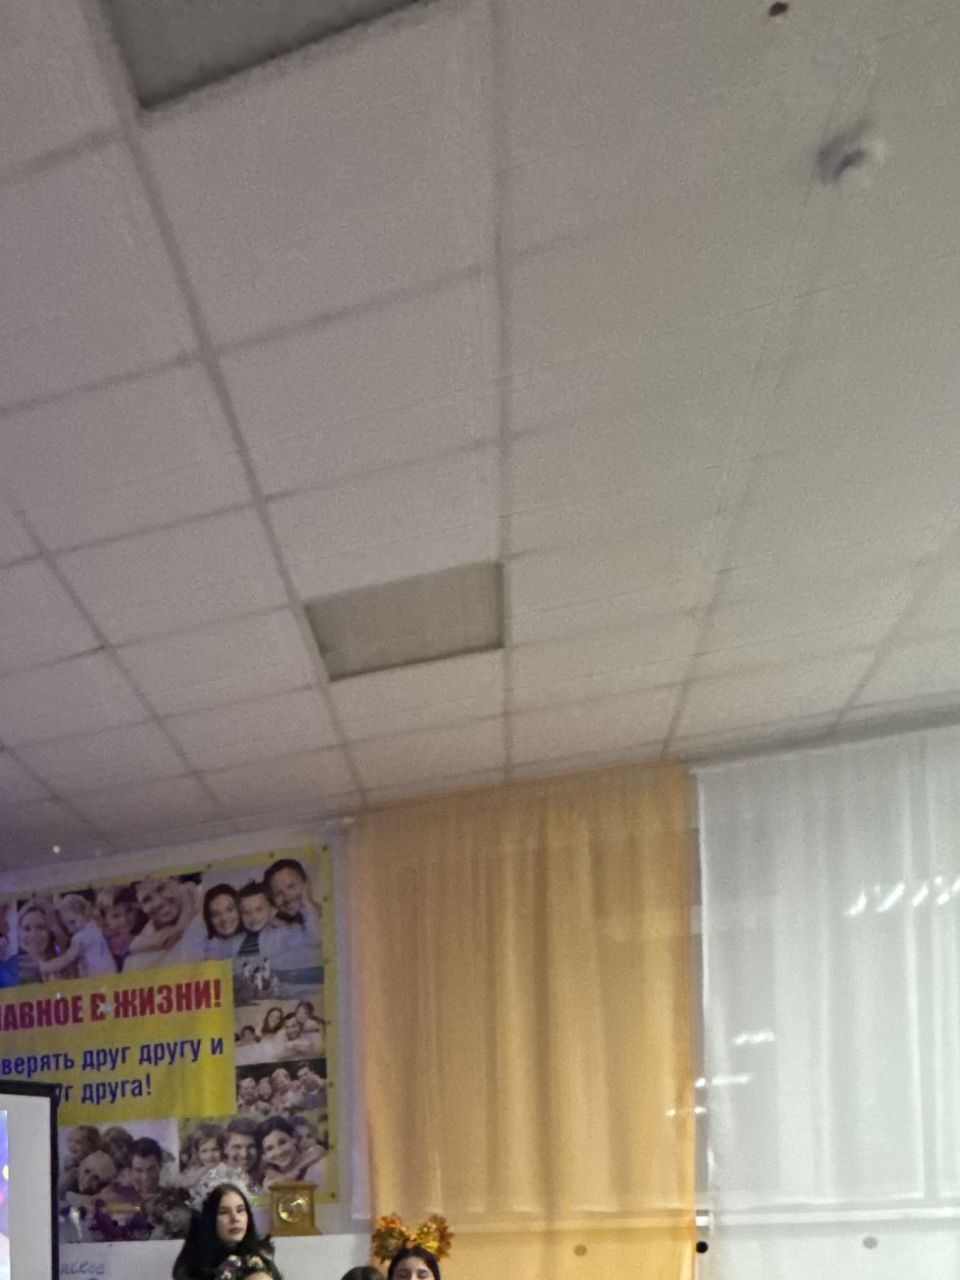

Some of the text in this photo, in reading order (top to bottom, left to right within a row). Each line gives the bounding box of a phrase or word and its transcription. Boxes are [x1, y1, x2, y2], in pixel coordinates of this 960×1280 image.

[113, 979, 222, 1019] ЖИЗНИ!
[82, 1046, 130, 1071] друг
[138, 1038, 202, 1065] другу
[210, 1037, 223, 1055] и
[81, 1073, 152, 1105] друга!
